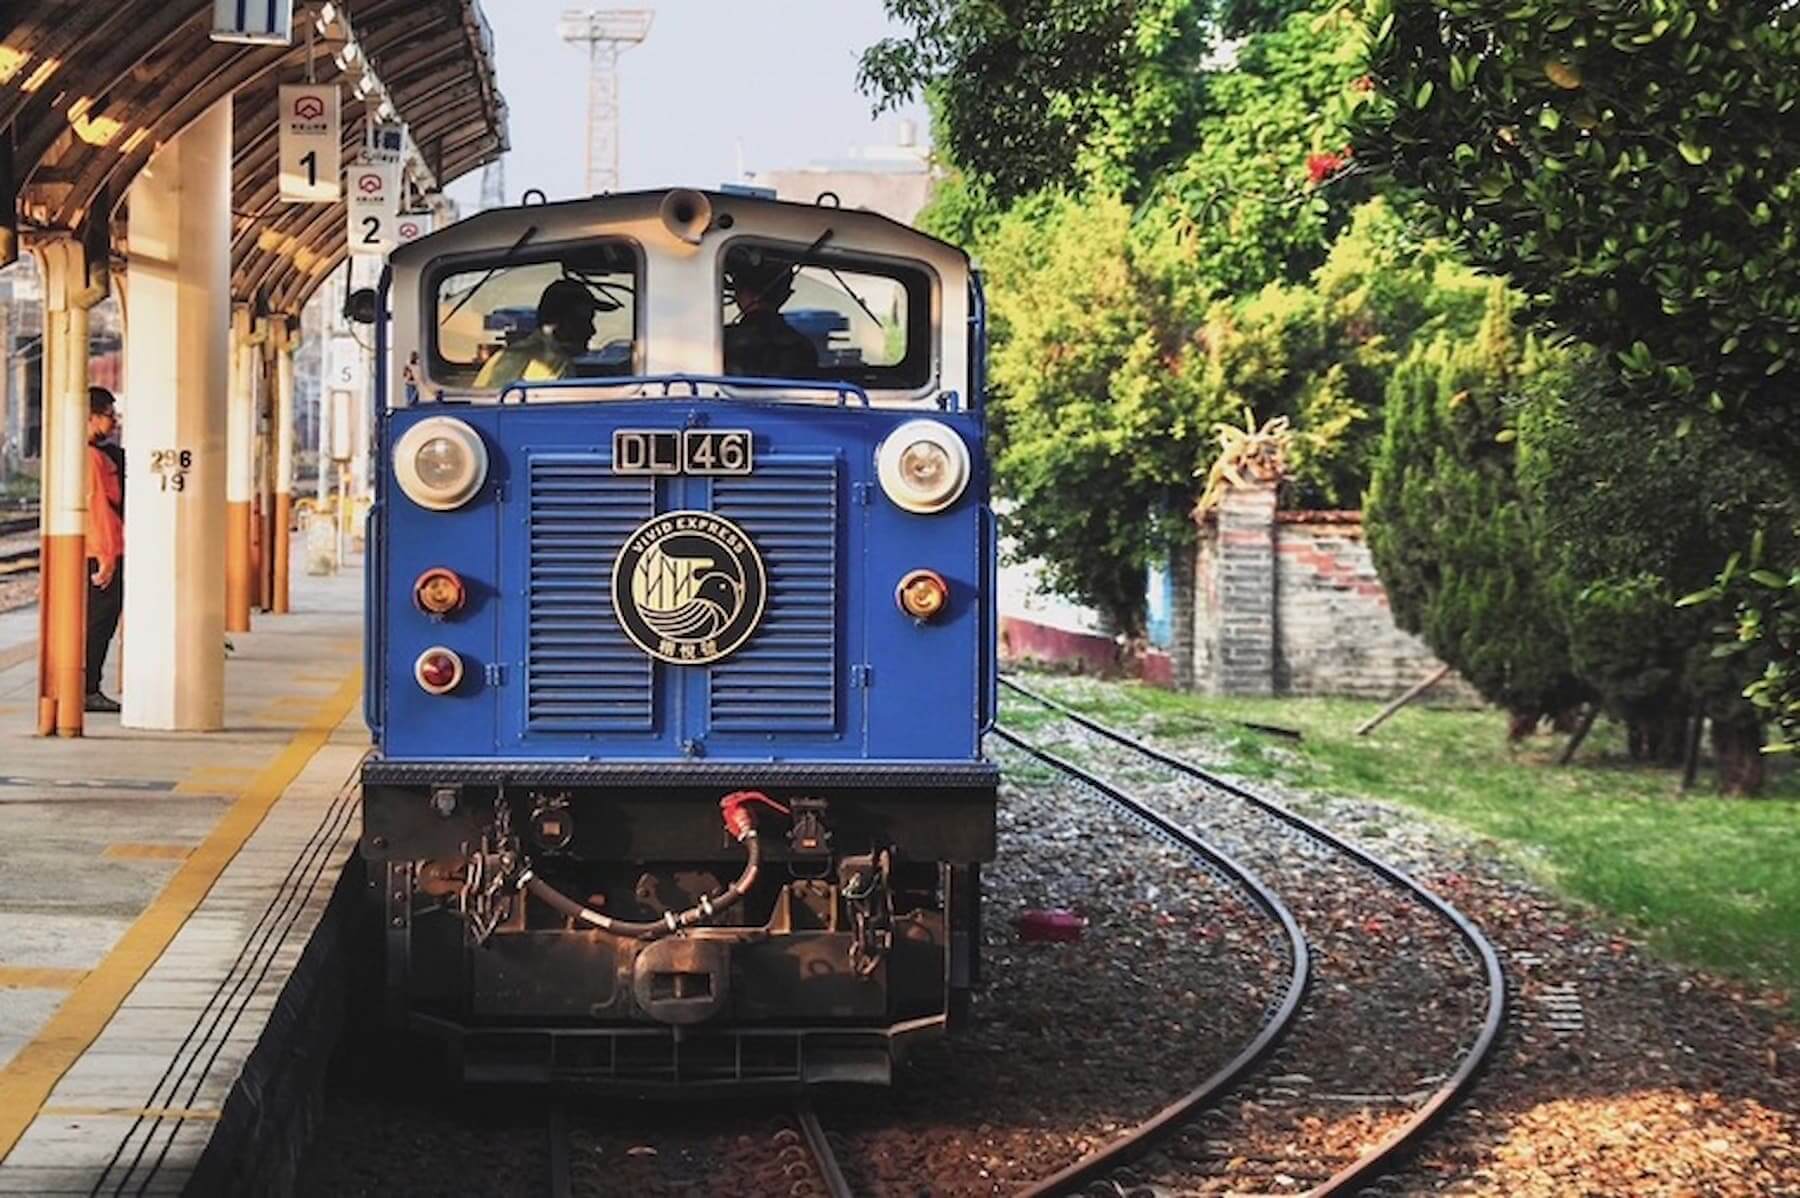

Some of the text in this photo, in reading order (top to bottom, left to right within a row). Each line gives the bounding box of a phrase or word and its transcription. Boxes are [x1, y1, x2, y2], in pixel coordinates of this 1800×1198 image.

[299, 150, 316, 187] 1
[361, 215, 381, 244] 2
[340, 365, 352, 383] 5
[621, 434, 744, 469] DL 46
[161, 472, 185, 492] 19
[631, 517, 746, 553] VIVID EXPRESS
